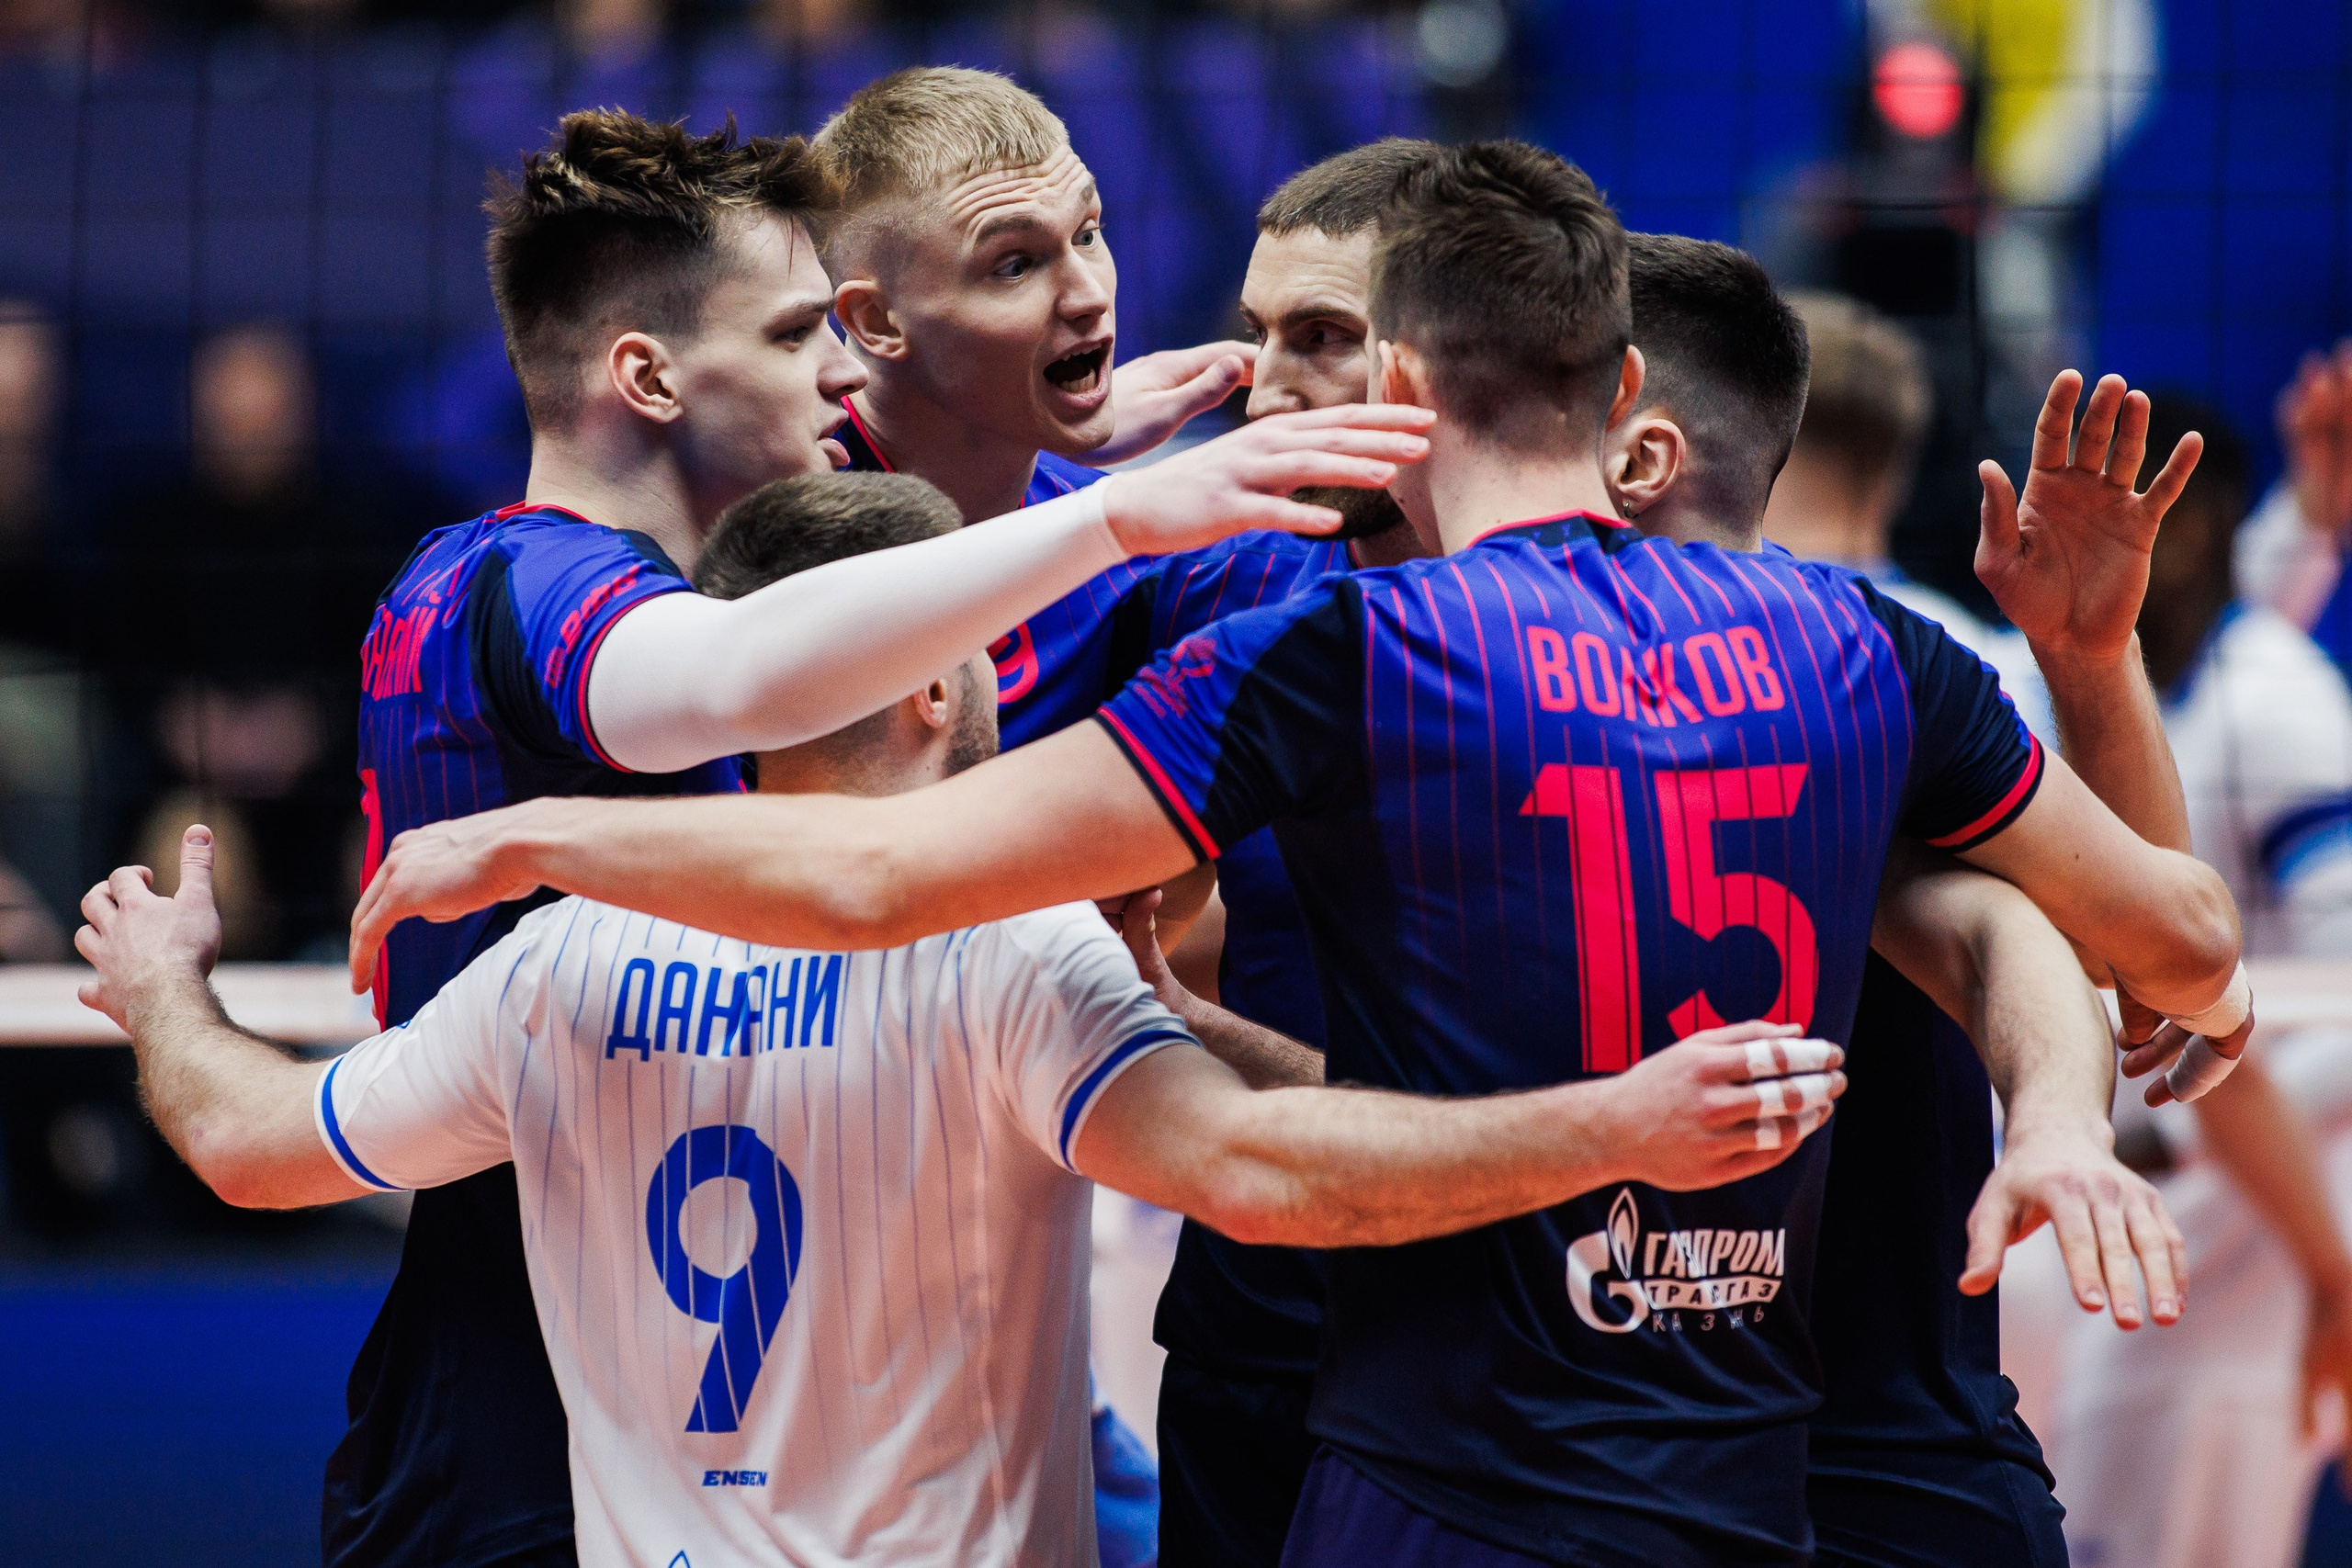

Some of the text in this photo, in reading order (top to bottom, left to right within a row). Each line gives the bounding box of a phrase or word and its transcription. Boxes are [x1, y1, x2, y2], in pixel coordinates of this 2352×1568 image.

[605, 954, 842, 1062] ДАНАНИ
[1519, 763, 1819, 1073] 15
[646, 1124, 803, 1433] 9
[1649, 1280, 1774, 1304] ТРАГАЗ
